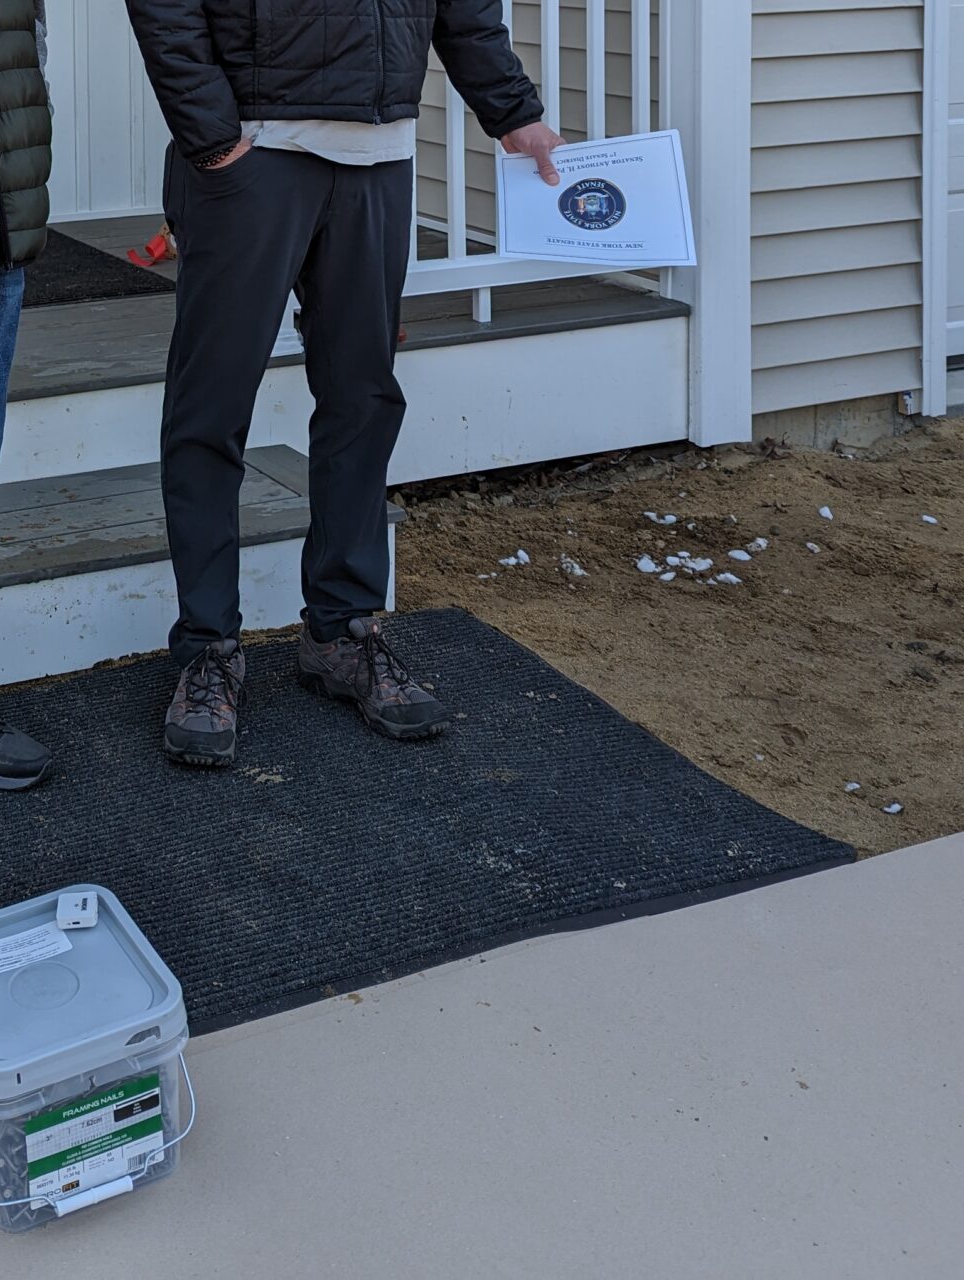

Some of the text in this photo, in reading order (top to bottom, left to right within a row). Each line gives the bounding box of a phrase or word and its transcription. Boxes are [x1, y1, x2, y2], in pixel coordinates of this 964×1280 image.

[577, 181, 606, 191] SENATE
[563, 210, 582, 225] STATE
[585, 221, 608, 229] YORK
[547, 237, 575, 246] SENATE
[577, 240, 600, 248] STATE
[62, 1090, 125, 1118] FRAMING NAILS
